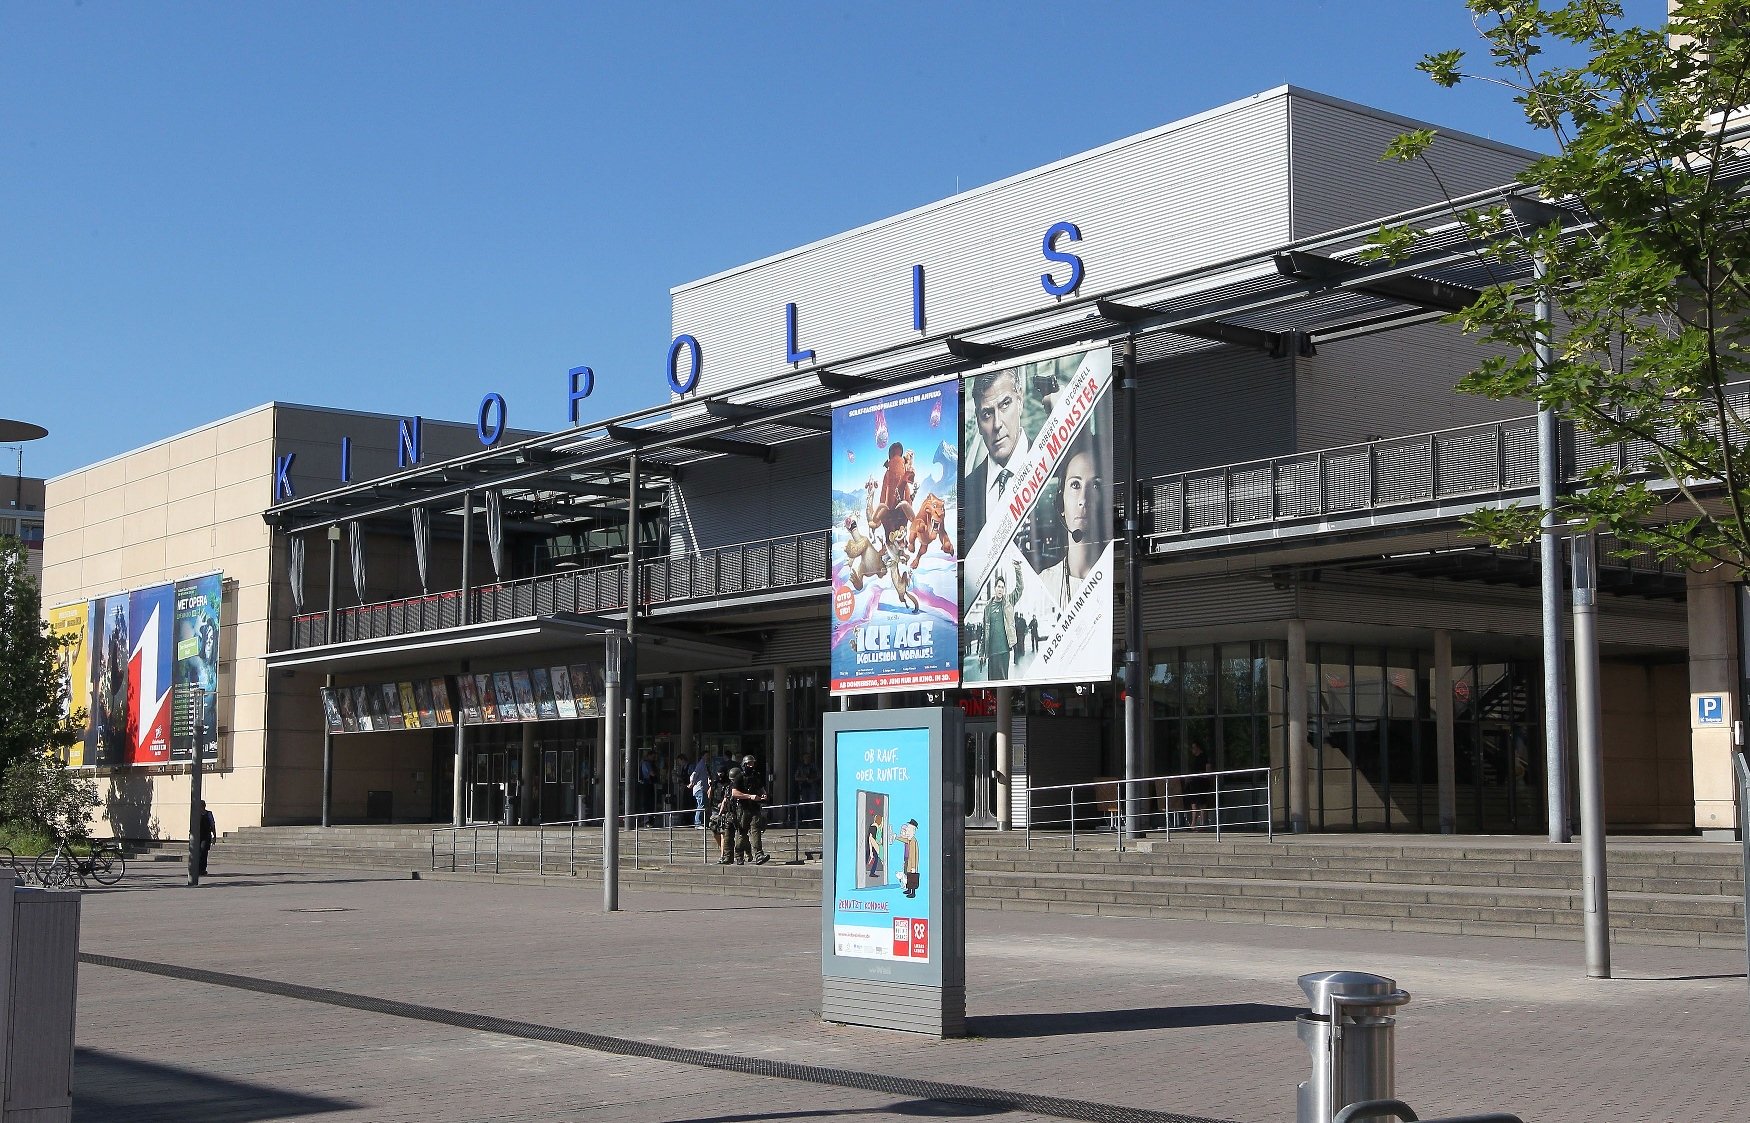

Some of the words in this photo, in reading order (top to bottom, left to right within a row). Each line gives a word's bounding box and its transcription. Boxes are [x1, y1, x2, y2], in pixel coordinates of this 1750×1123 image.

[275, 221, 1085, 500] KINOPOLIS
[1065, 366, 1091, 406] O'CONNELL
[1009, 457, 1049, 521] MONEY
[1046, 377, 1099, 461] MONSTER
[1038, 417, 1059, 451] ROBERTS
[1012, 460, 1035, 494] CLOONEY
[1042, 647, 1055, 664] AB
[1051, 633, 1065, 648] 26.
[1061, 611, 1076, 632] MAI
[1074, 596, 1086, 613] IM
[1082, 570, 1104, 599] KINO
[856, 624, 892, 652] ICE
[893, 620, 934, 649] AGE
[856, 650, 897, 665] KOLLISION
[898, 646, 934, 661] VORAUS!
[1703, 698, 1717, 717] P
[864, 748, 875, 764] OB
[855, 768, 875, 782] ODER
[876, 766, 911, 782] RUNTER.
